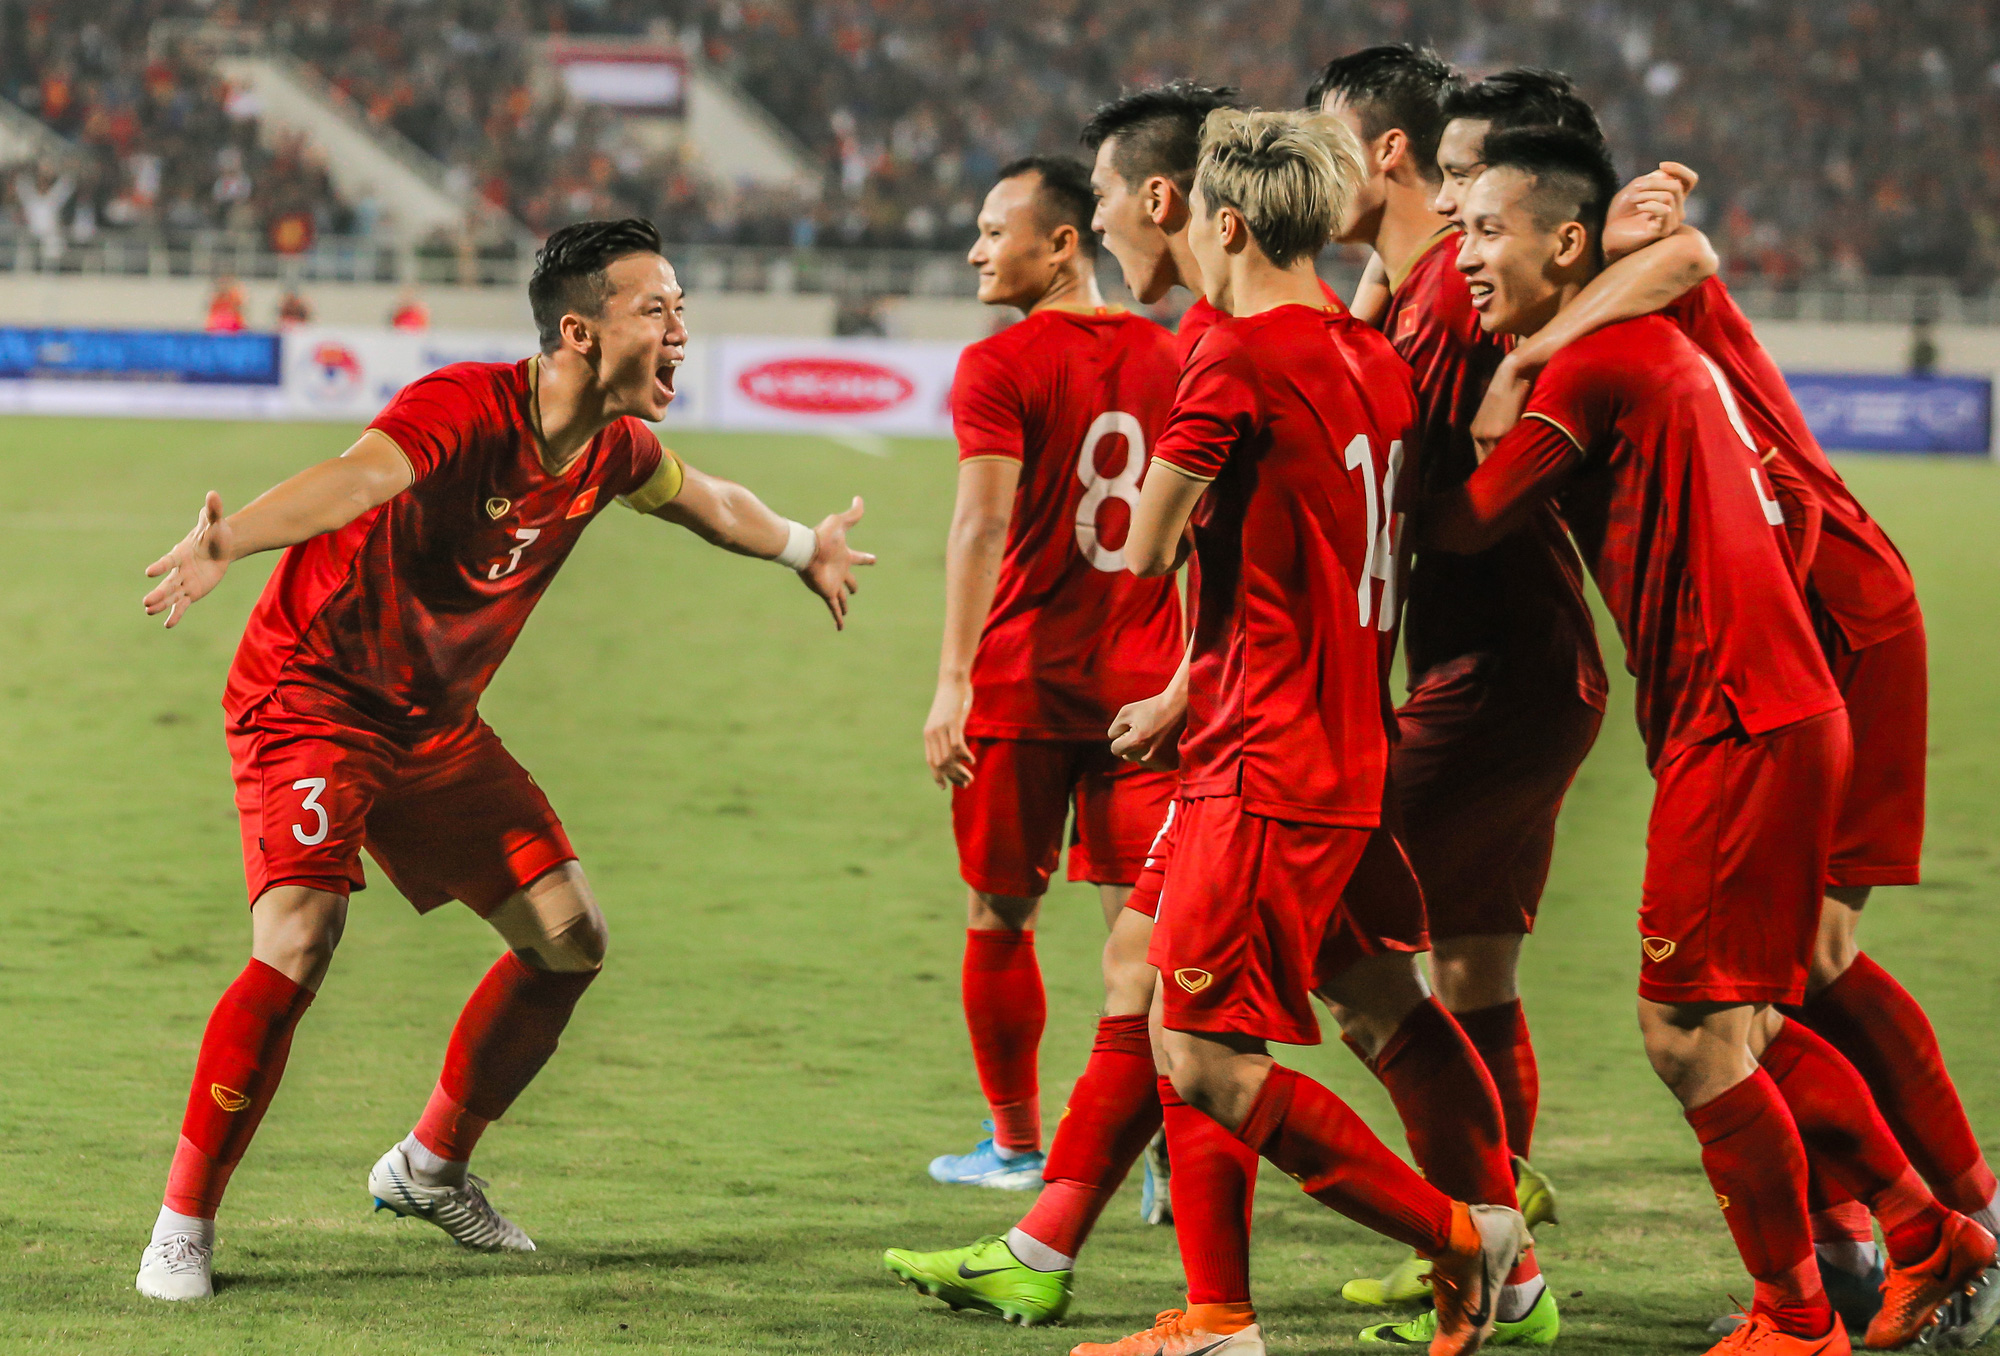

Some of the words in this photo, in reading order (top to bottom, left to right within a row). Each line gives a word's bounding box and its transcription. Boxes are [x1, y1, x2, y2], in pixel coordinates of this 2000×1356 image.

[1075, 411, 1145, 572] 8
[488, 528, 541, 580] 3
[291, 777, 329, 846] 3
